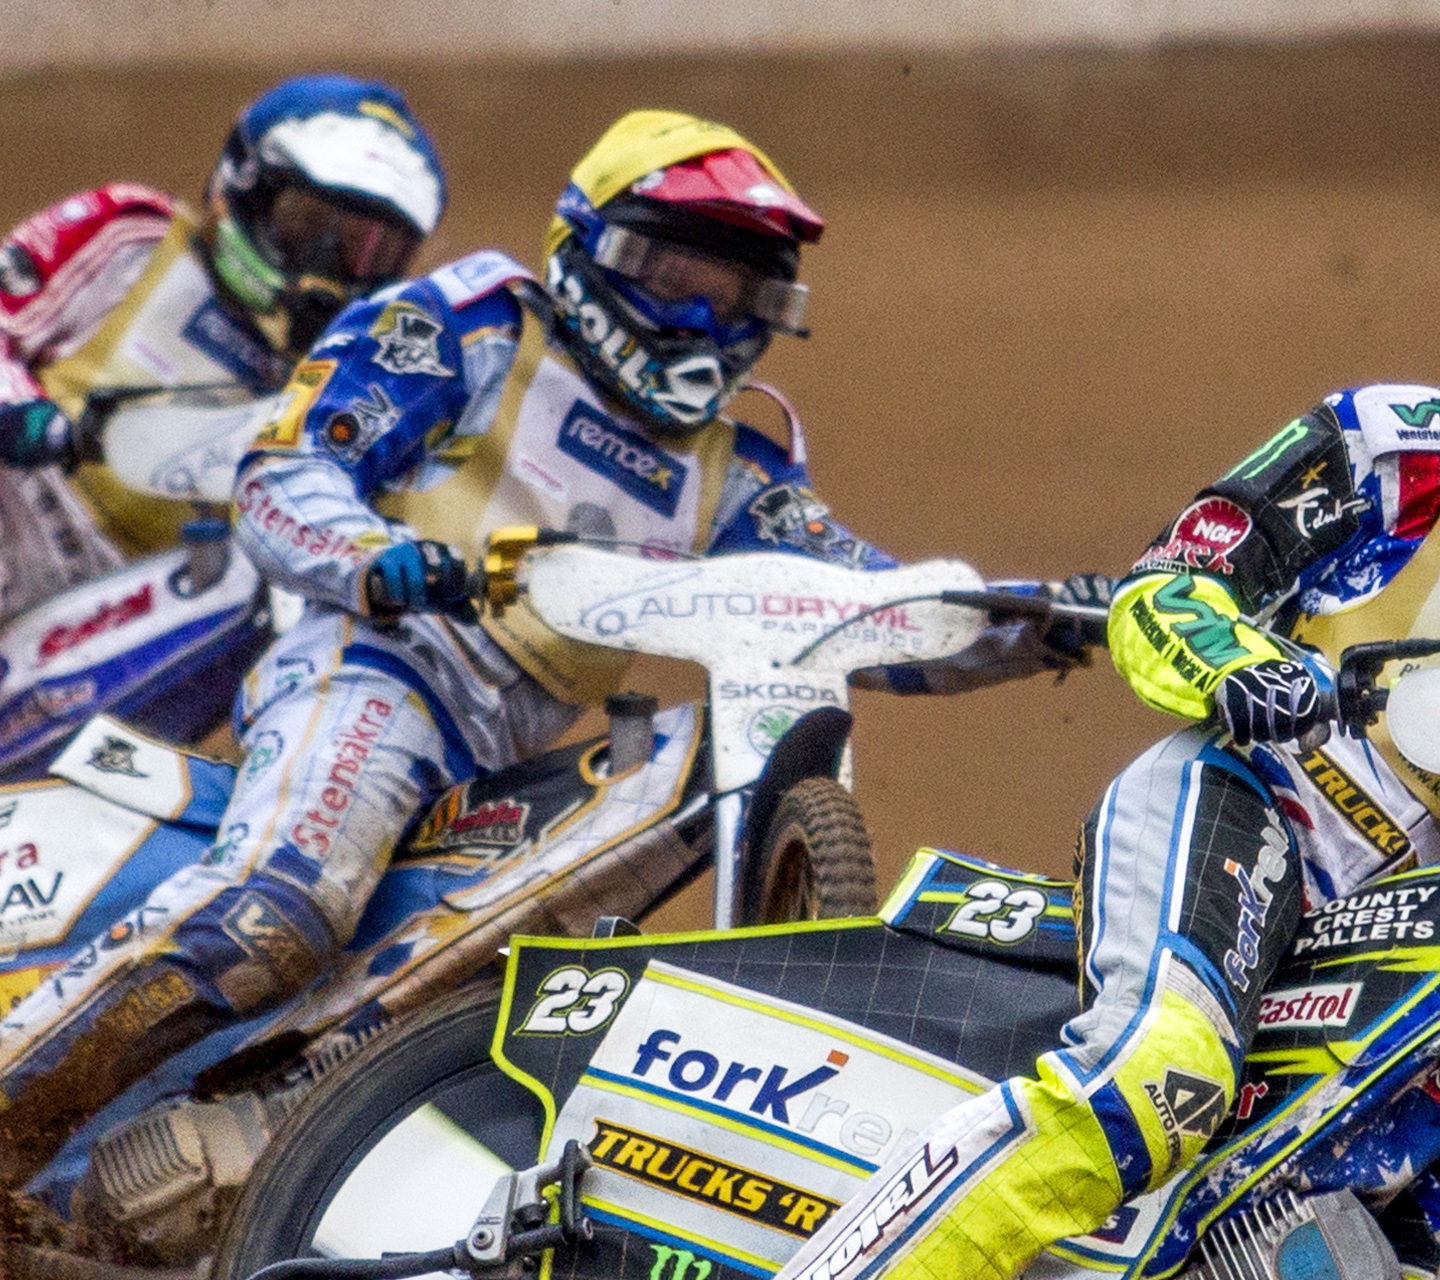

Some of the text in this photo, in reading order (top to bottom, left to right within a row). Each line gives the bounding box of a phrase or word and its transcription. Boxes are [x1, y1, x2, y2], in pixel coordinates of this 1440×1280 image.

[1193, 519, 1241, 545] NGK
[720, 681, 839, 704] ŠKODA
[947, 880, 1046, 943] 23
[1313, 905, 1418, 934] CREST
[1293, 922, 1435, 956] PALLETS
[522, 967, 628, 1034] 23
[1143, 1083, 1177, 1132] AUTO
[592, 1127, 775, 1213] TRUCKS
